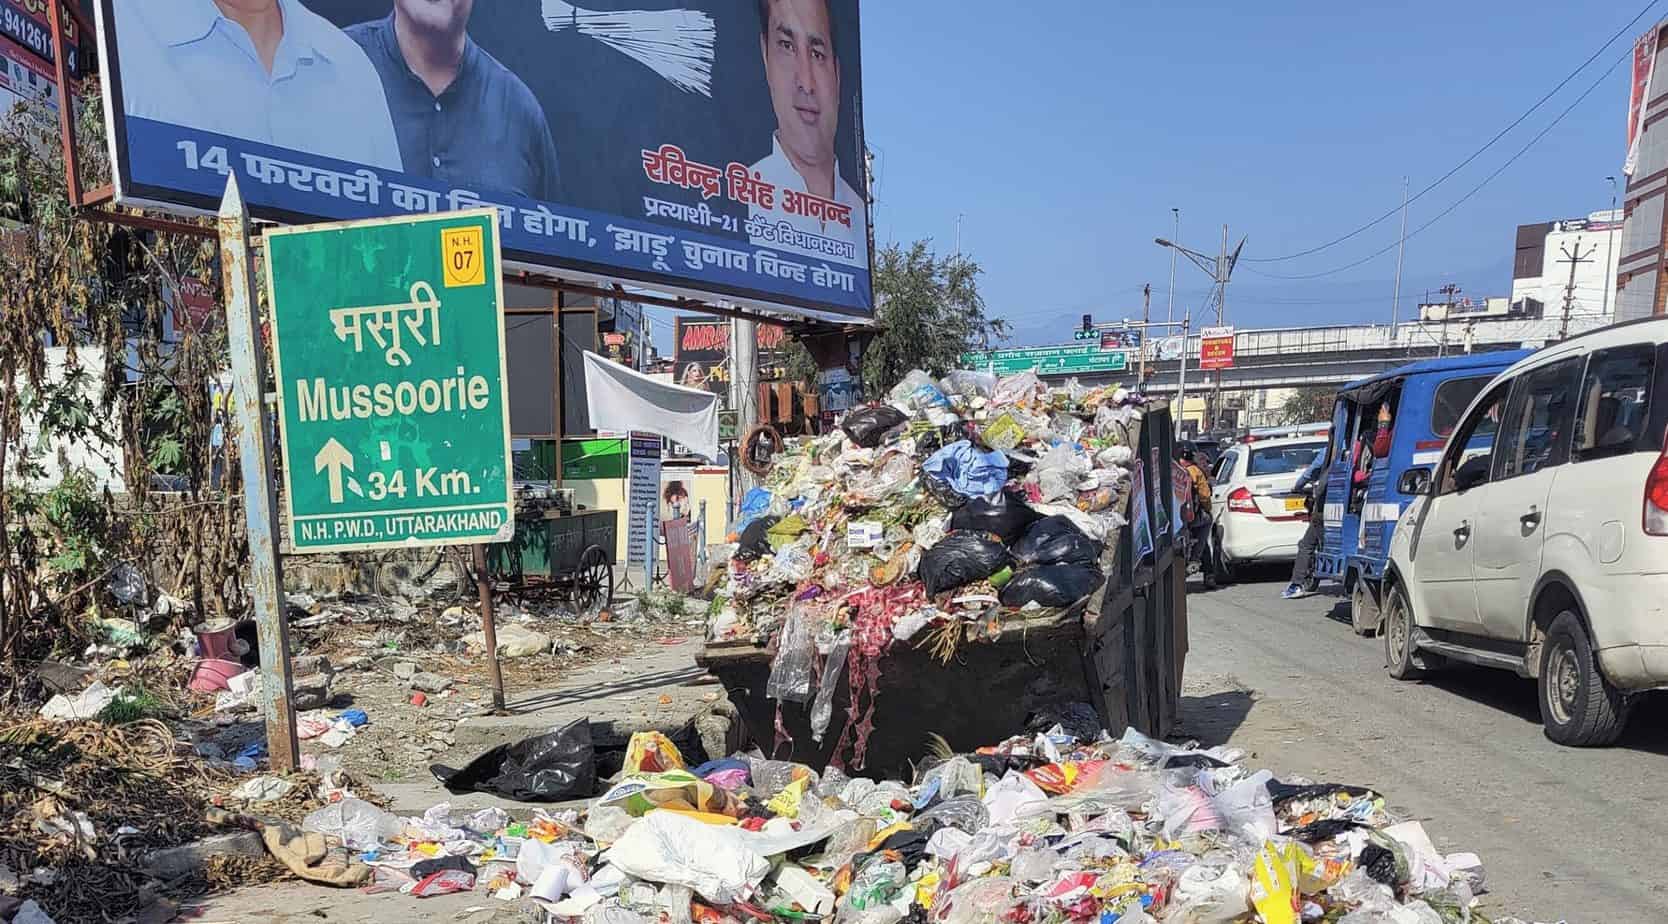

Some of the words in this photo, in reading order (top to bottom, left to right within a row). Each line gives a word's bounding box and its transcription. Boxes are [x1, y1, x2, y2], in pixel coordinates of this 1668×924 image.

[641, 144, 722, 200] रविन्द्र
[726, 162, 775, 211] सिंह
[782, 189, 852, 229] आनन्द
[177, 139, 230, 175] 14
[240, 152, 382, 205] फरवरी
[387, 182, 442, 213] का
[520, 204, 596, 248] होगा,
[680, 239, 750, 275] चुनाव
[753, 249, 808, 283] चिन्ह
[809, 263, 855, 292] होगा
[453, 251, 473, 270] 07
[329, 281, 441, 366] मसूरी
[297, 366, 489, 422] Mussoorie
[368, 470, 407, 500] 34
[416, 466, 481, 496] Km.
[386, 510, 500, 536] UTTARAKHAND
